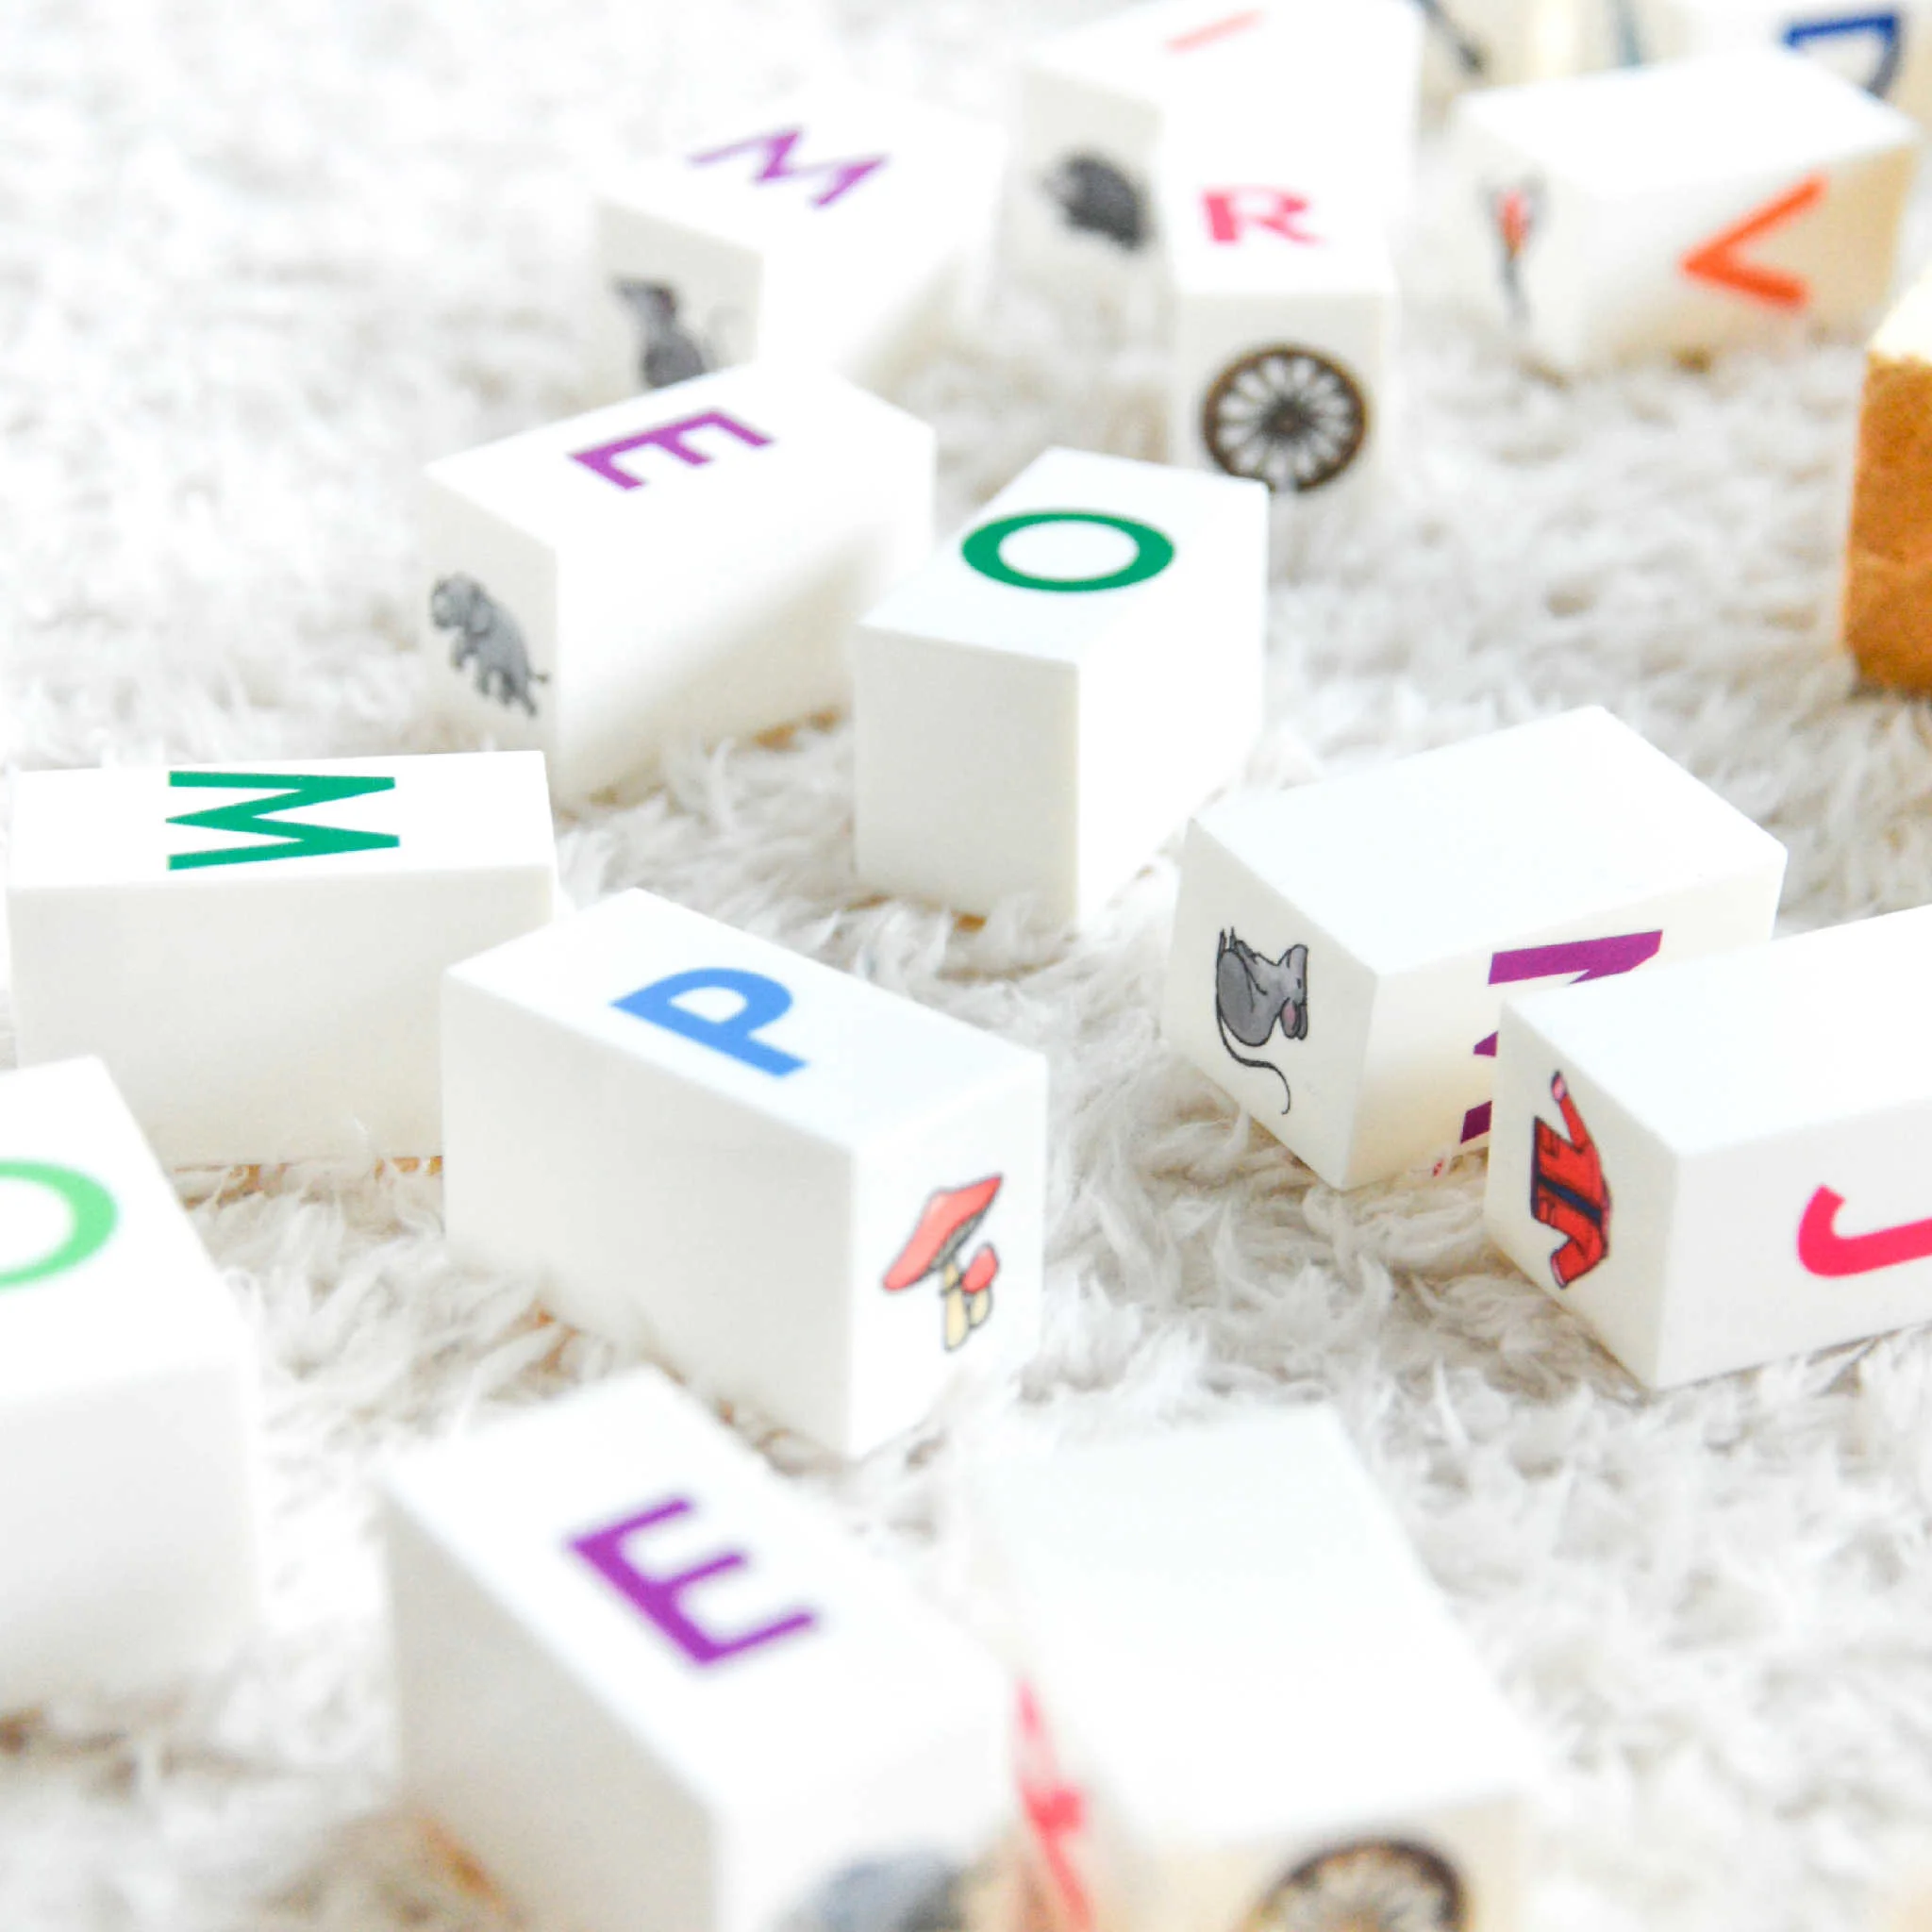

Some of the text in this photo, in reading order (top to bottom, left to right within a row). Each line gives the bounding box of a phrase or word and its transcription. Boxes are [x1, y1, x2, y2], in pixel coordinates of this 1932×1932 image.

[1200, 188, 1321, 247] R
[573, 411, 771, 491] E
[960, 509, 1175, 594] O
[610, 967, 808, 1079] P
[568, 1498, 815, 1668] E
